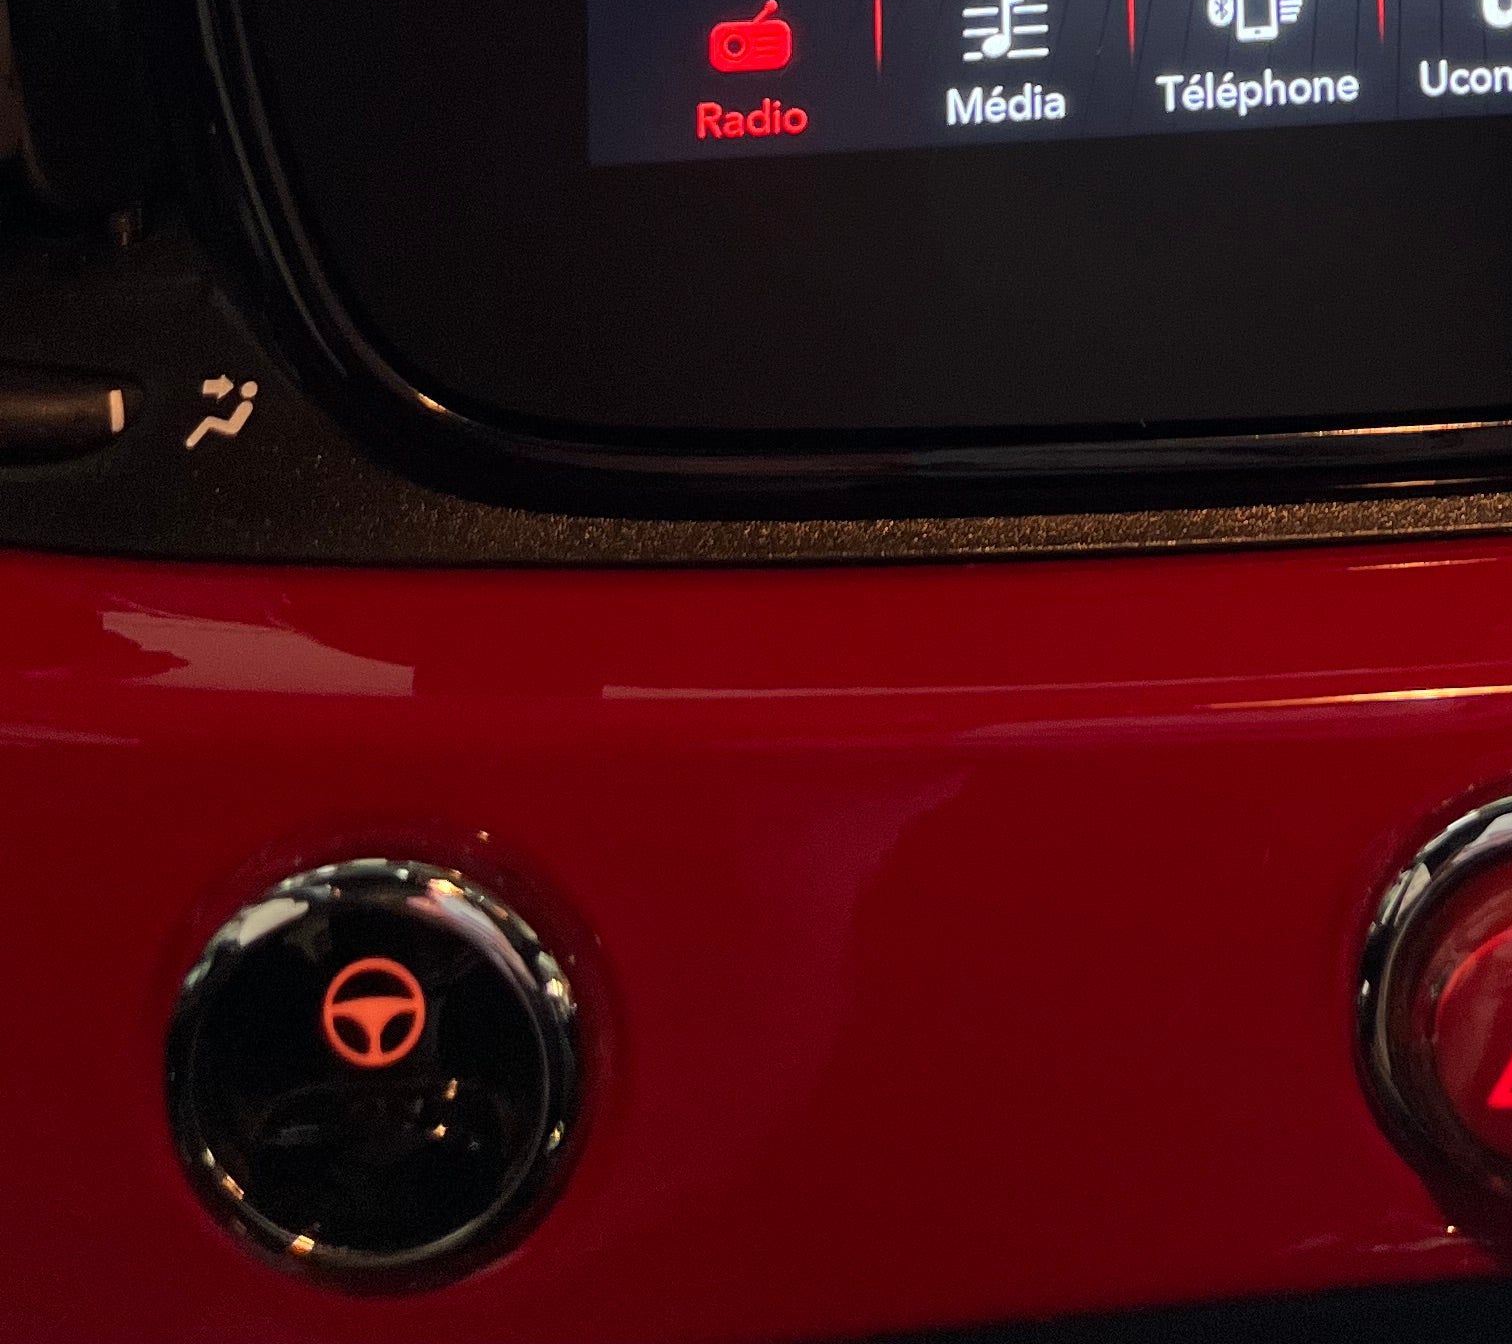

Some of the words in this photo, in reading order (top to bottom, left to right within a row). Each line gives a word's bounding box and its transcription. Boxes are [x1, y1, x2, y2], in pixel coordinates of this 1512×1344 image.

[946, 81, 1067, 127] Média
[1154, 67, 1361, 118] Téléphone
[695, 96, 809, 140] Radio
